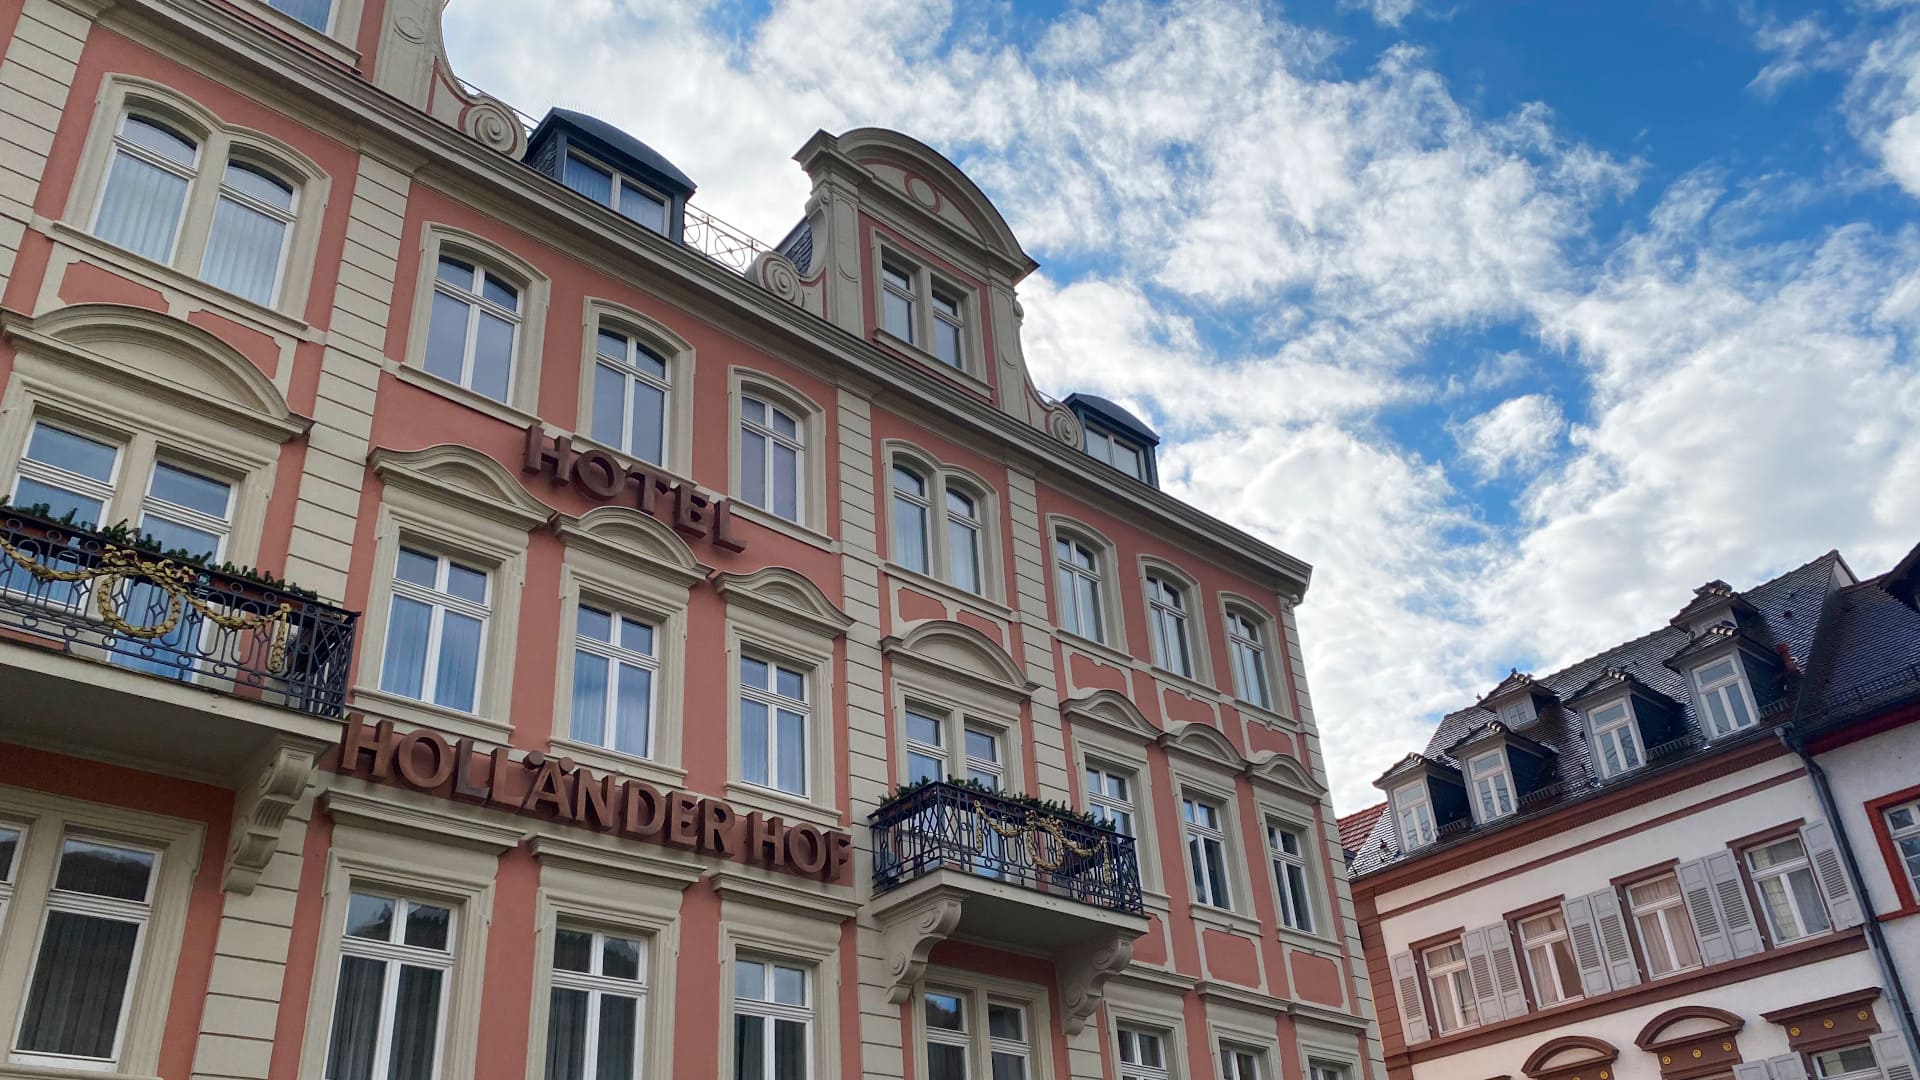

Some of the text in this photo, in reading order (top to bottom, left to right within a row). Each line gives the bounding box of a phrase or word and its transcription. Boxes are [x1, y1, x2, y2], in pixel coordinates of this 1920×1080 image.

[523, 425, 745, 553] HOTEL
[341, 713, 852, 880] HOLLÄNDER HOF
